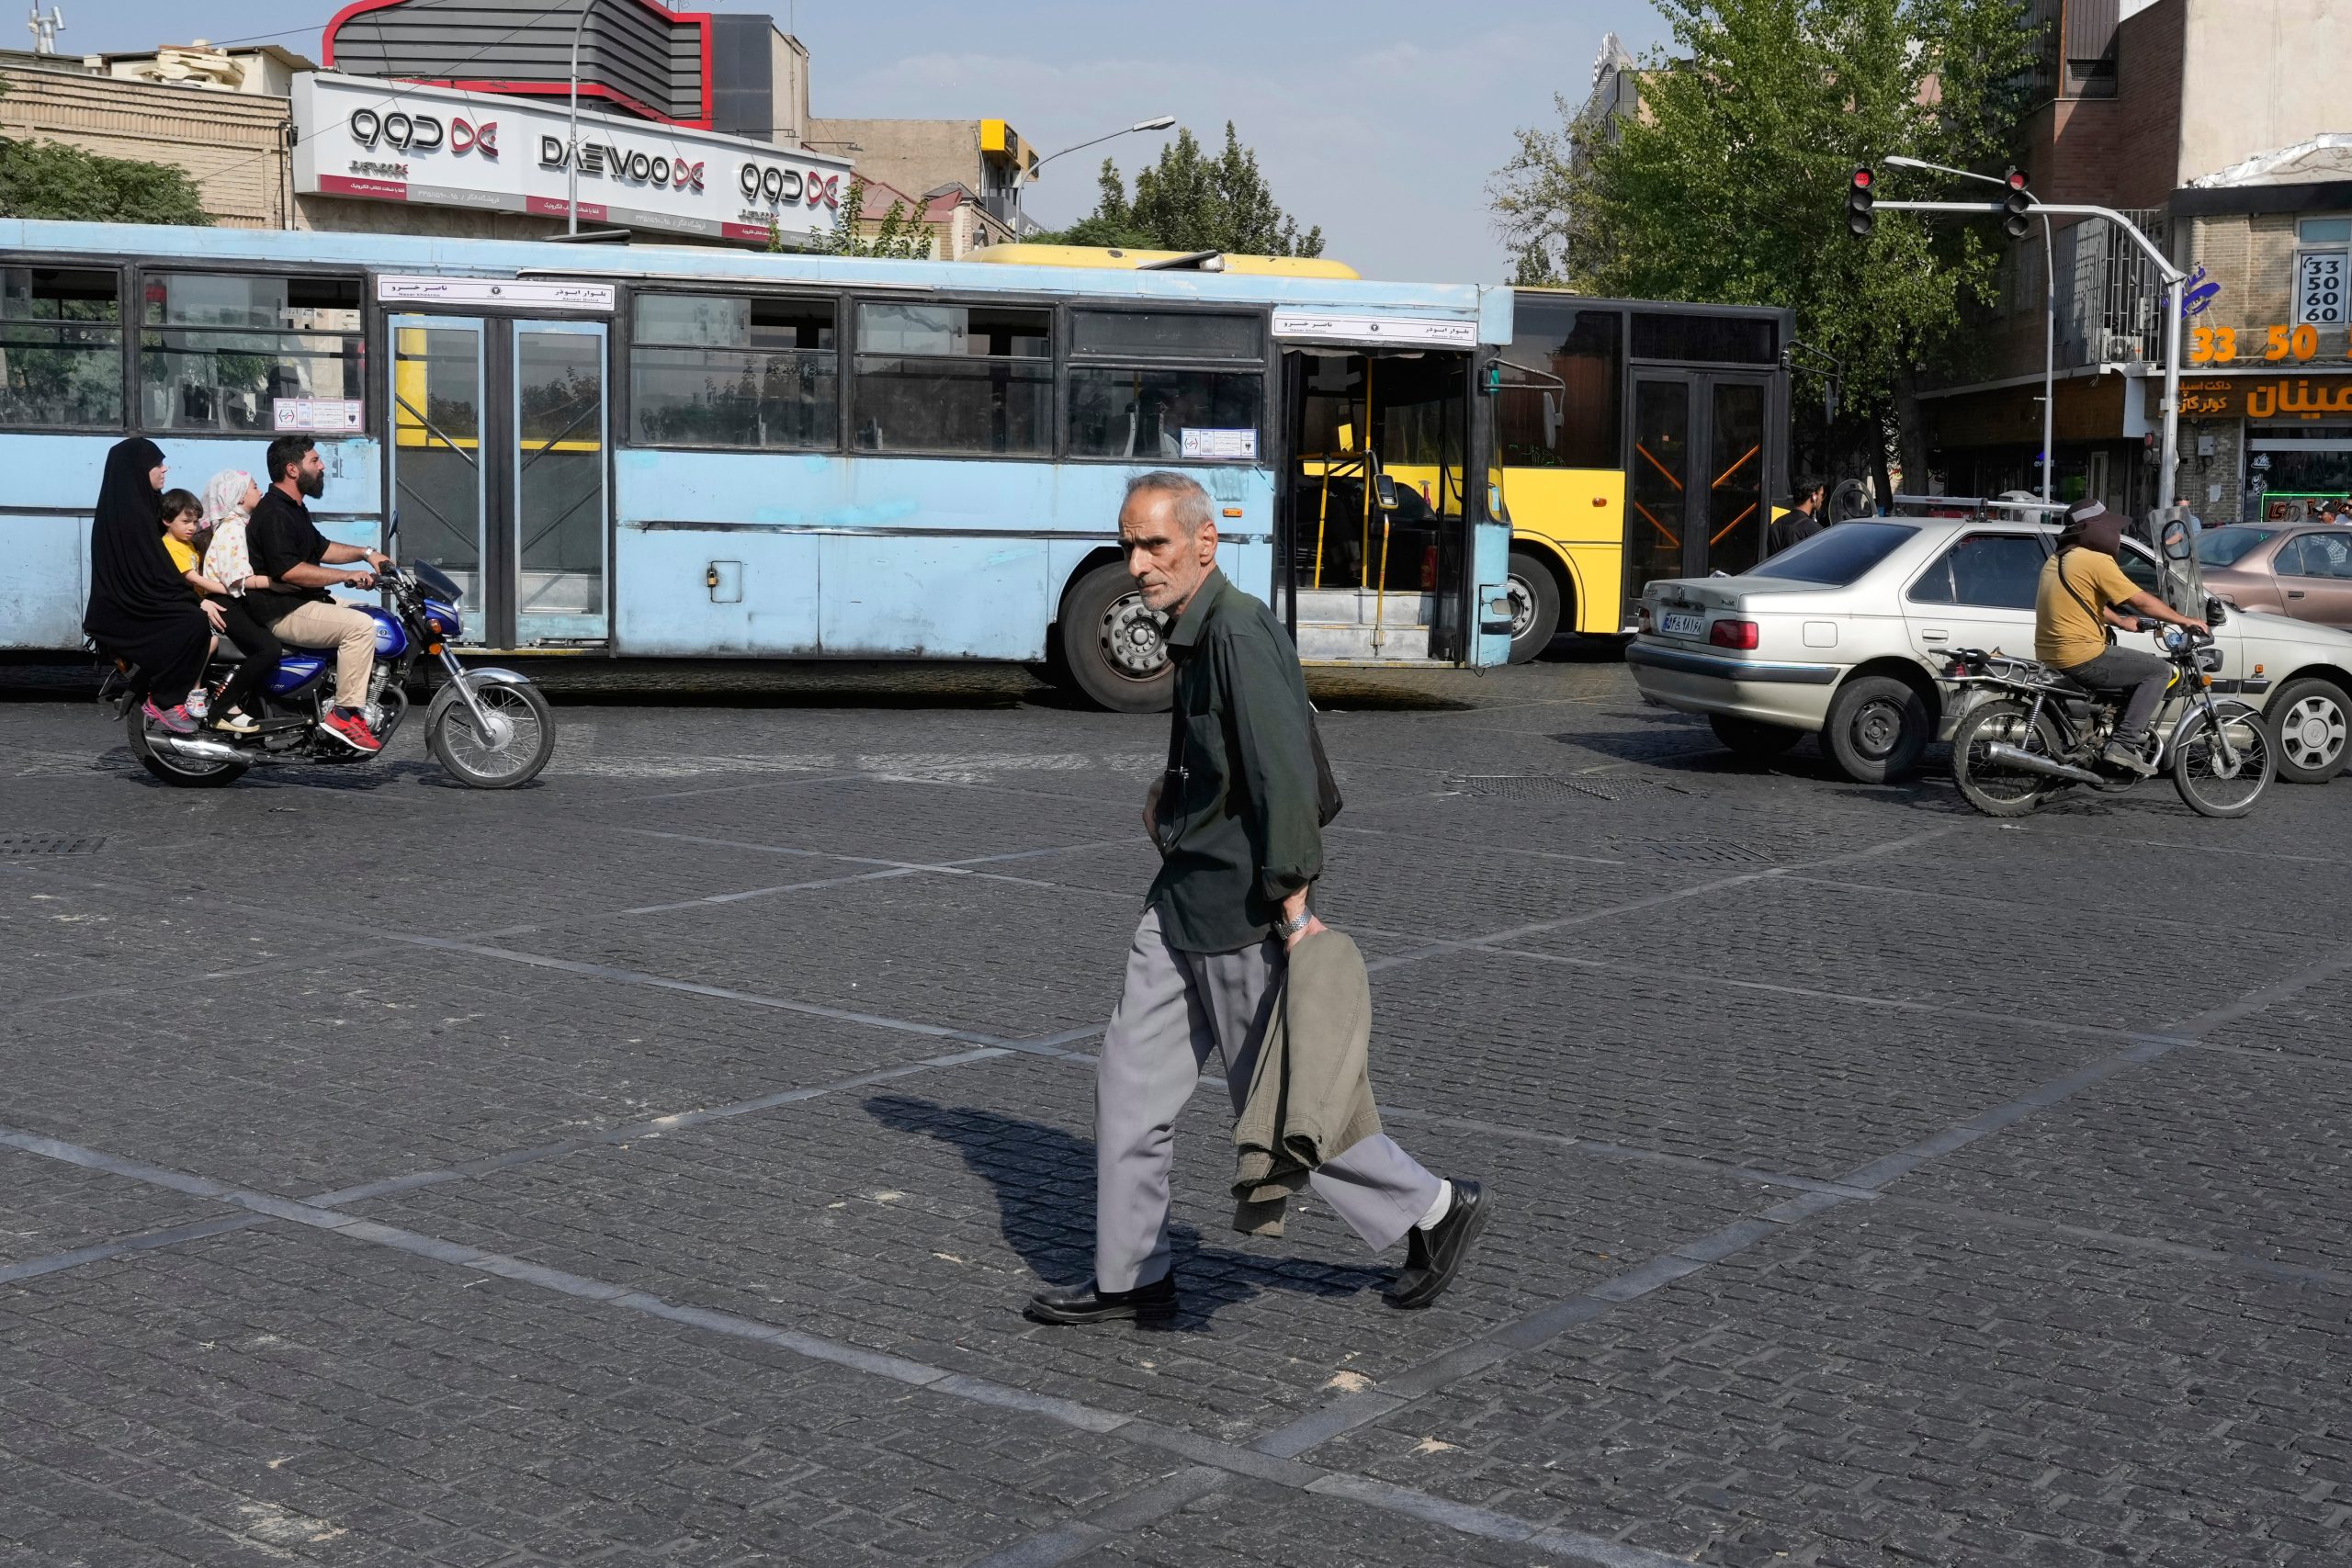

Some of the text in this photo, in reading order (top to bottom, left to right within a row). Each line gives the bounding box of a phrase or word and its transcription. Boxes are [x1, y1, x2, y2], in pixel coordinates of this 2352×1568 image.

[2307, 276, 2339, 290] 50
[2306, 292, 2338, 306] 60
[2305, 308, 2337, 321] 60
[2191, 327, 2237, 362] 33
[2265, 324, 2318, 361] 50
